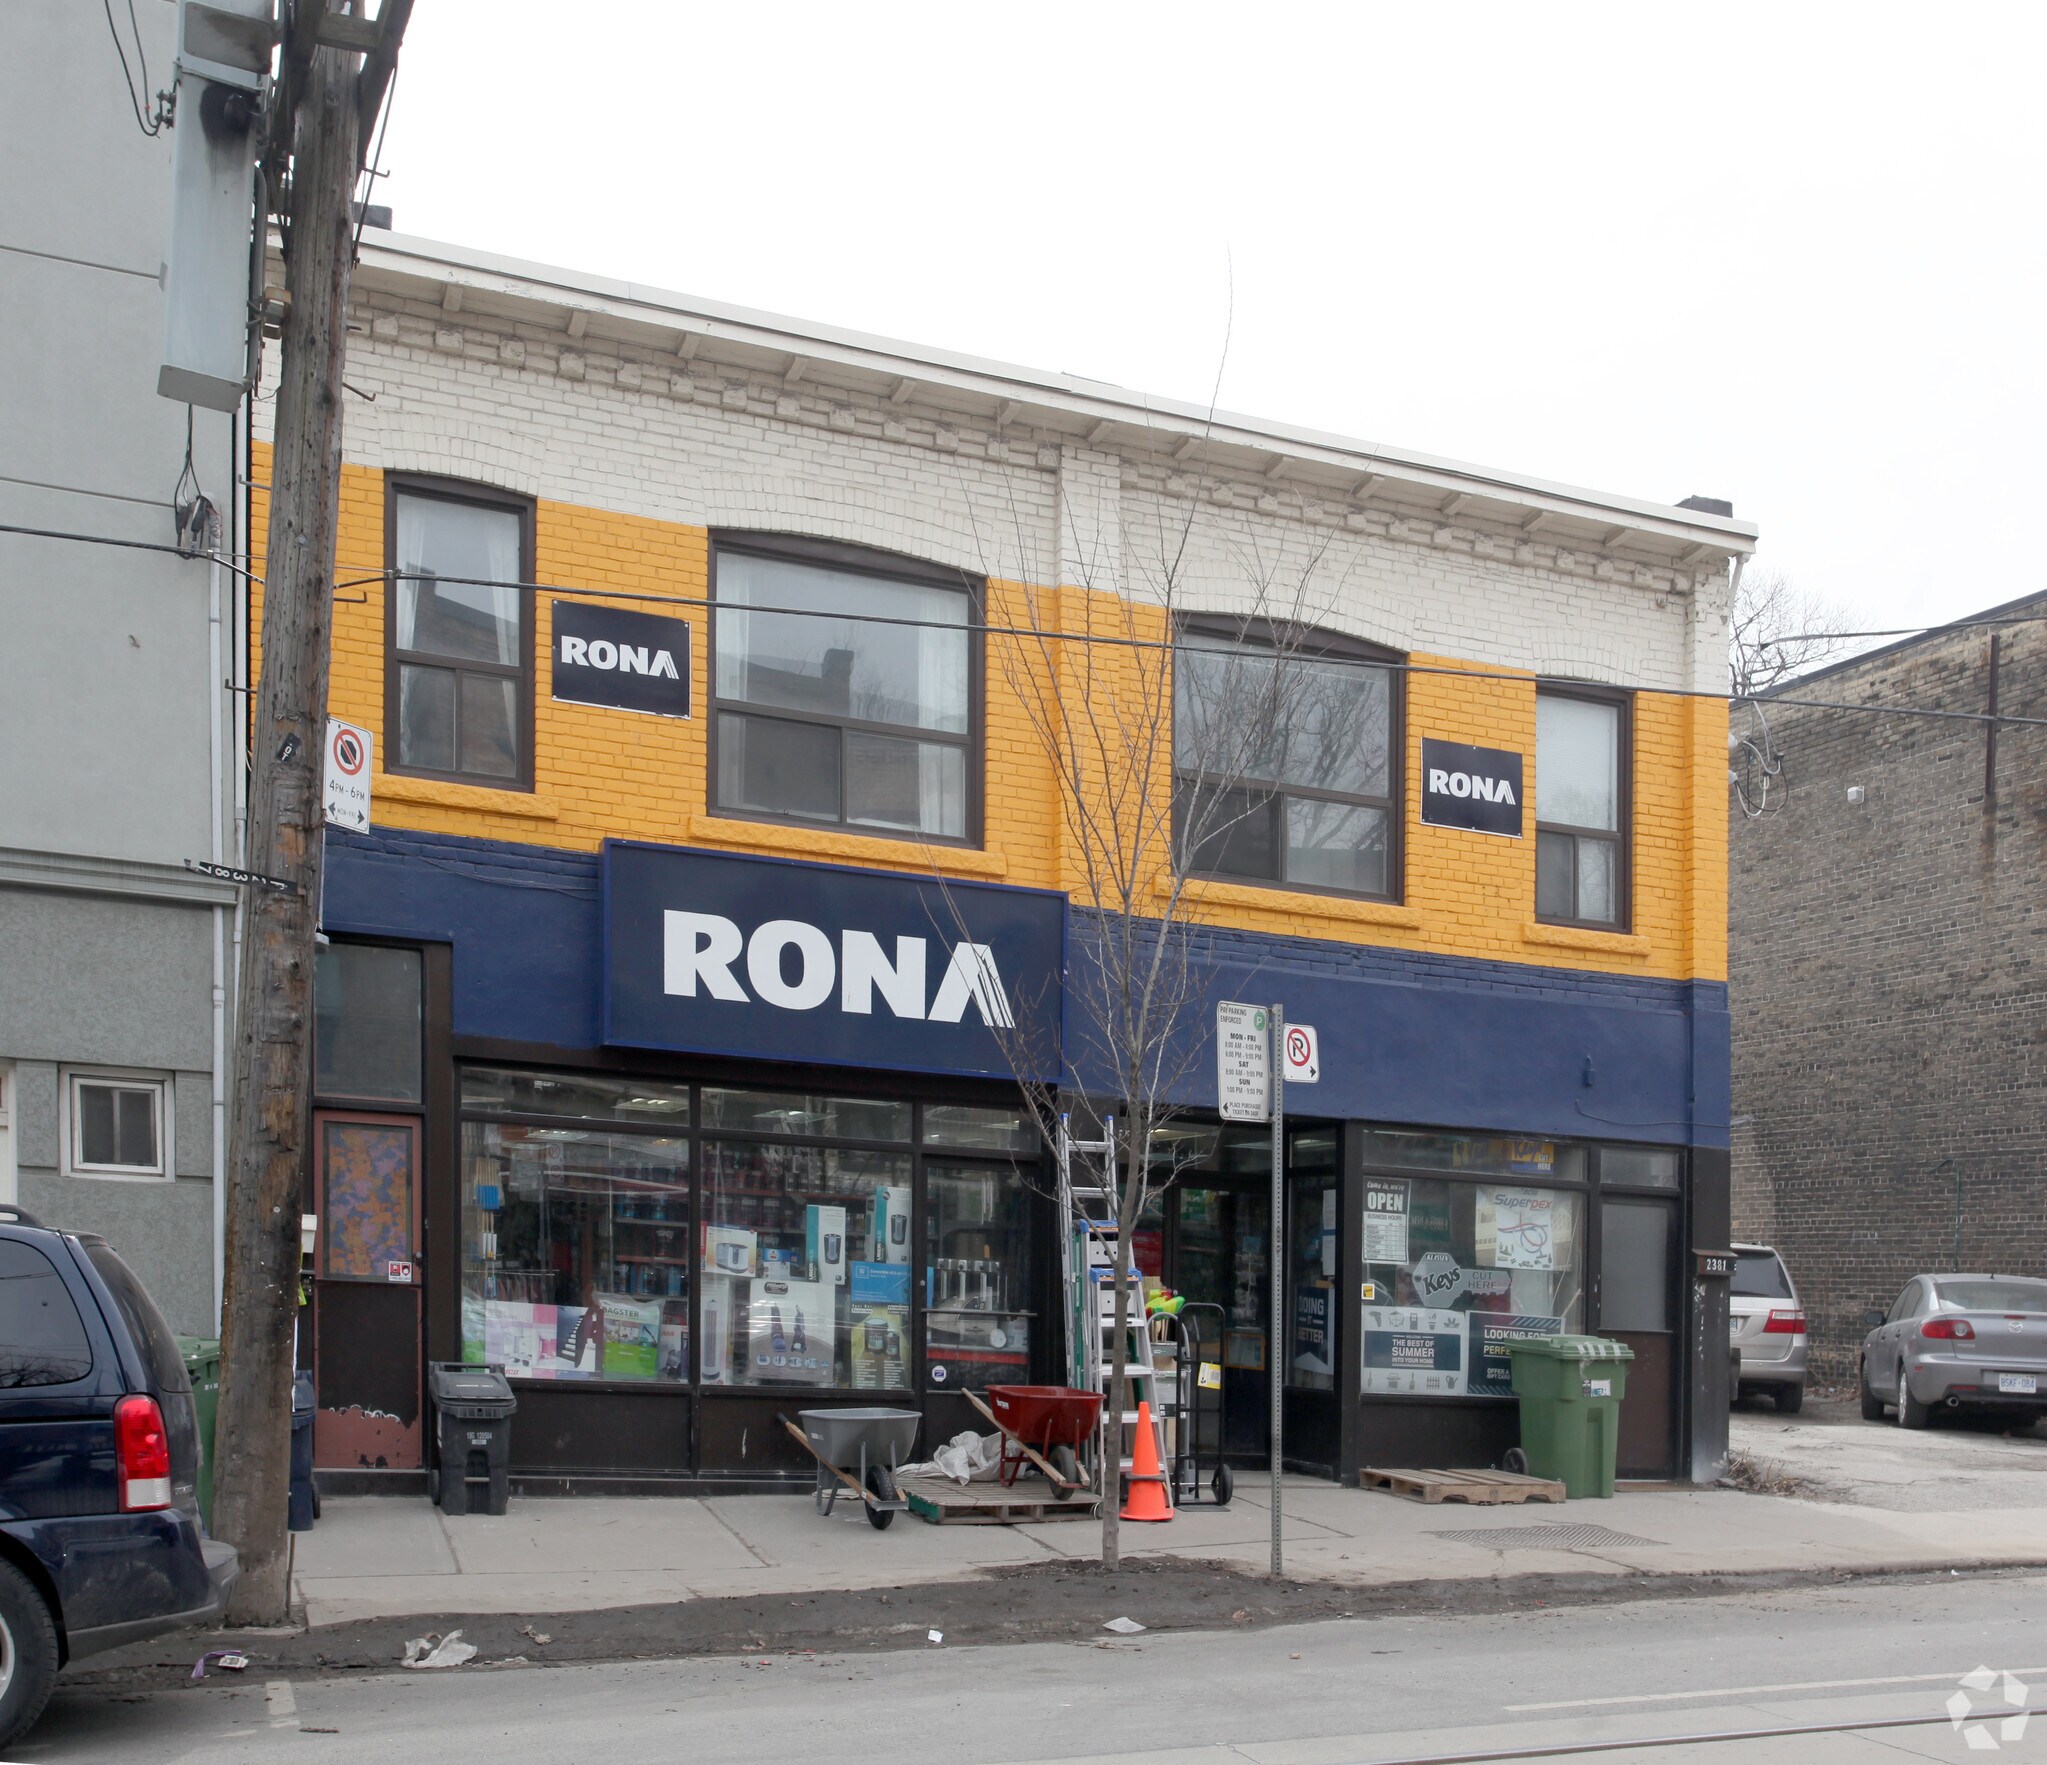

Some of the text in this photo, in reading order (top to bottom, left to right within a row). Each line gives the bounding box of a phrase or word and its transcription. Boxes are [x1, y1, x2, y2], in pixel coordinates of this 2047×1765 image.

[561, 635, 680, 680] RONA
[1429, 768, 1516, 806] RONA
[664, 909, 1016, 1029] RONA
[1228, 1007, 1247, 1016] PARKING
[1220, 1016, 1242, 1024] ENFORCED
[1256, 1088, 1264, 1096] PM
[1537, 1163, 1551, 1171] HERE
[1367, 1191, 1404, 1212] OPEN
[1706, 1259, 1727, 1272] 2381
[1472, 1272, 1493, 1280] CUT
[1422, 1268, 1461, 1296] Keys
[1468, 1281, 1496, 1290] HERE
[1298, 1296, 1324, 1315] DOING
[603, 1306, 640, 1318] BAGSTER
[1484, 1328, 1525, 1339] LOOKING
[1392, 1339, 1406, 1347] THE
[1392, 1347, 1435, 1358] SUMMER
[1484, 1345, 1511, 1355] PERFE
